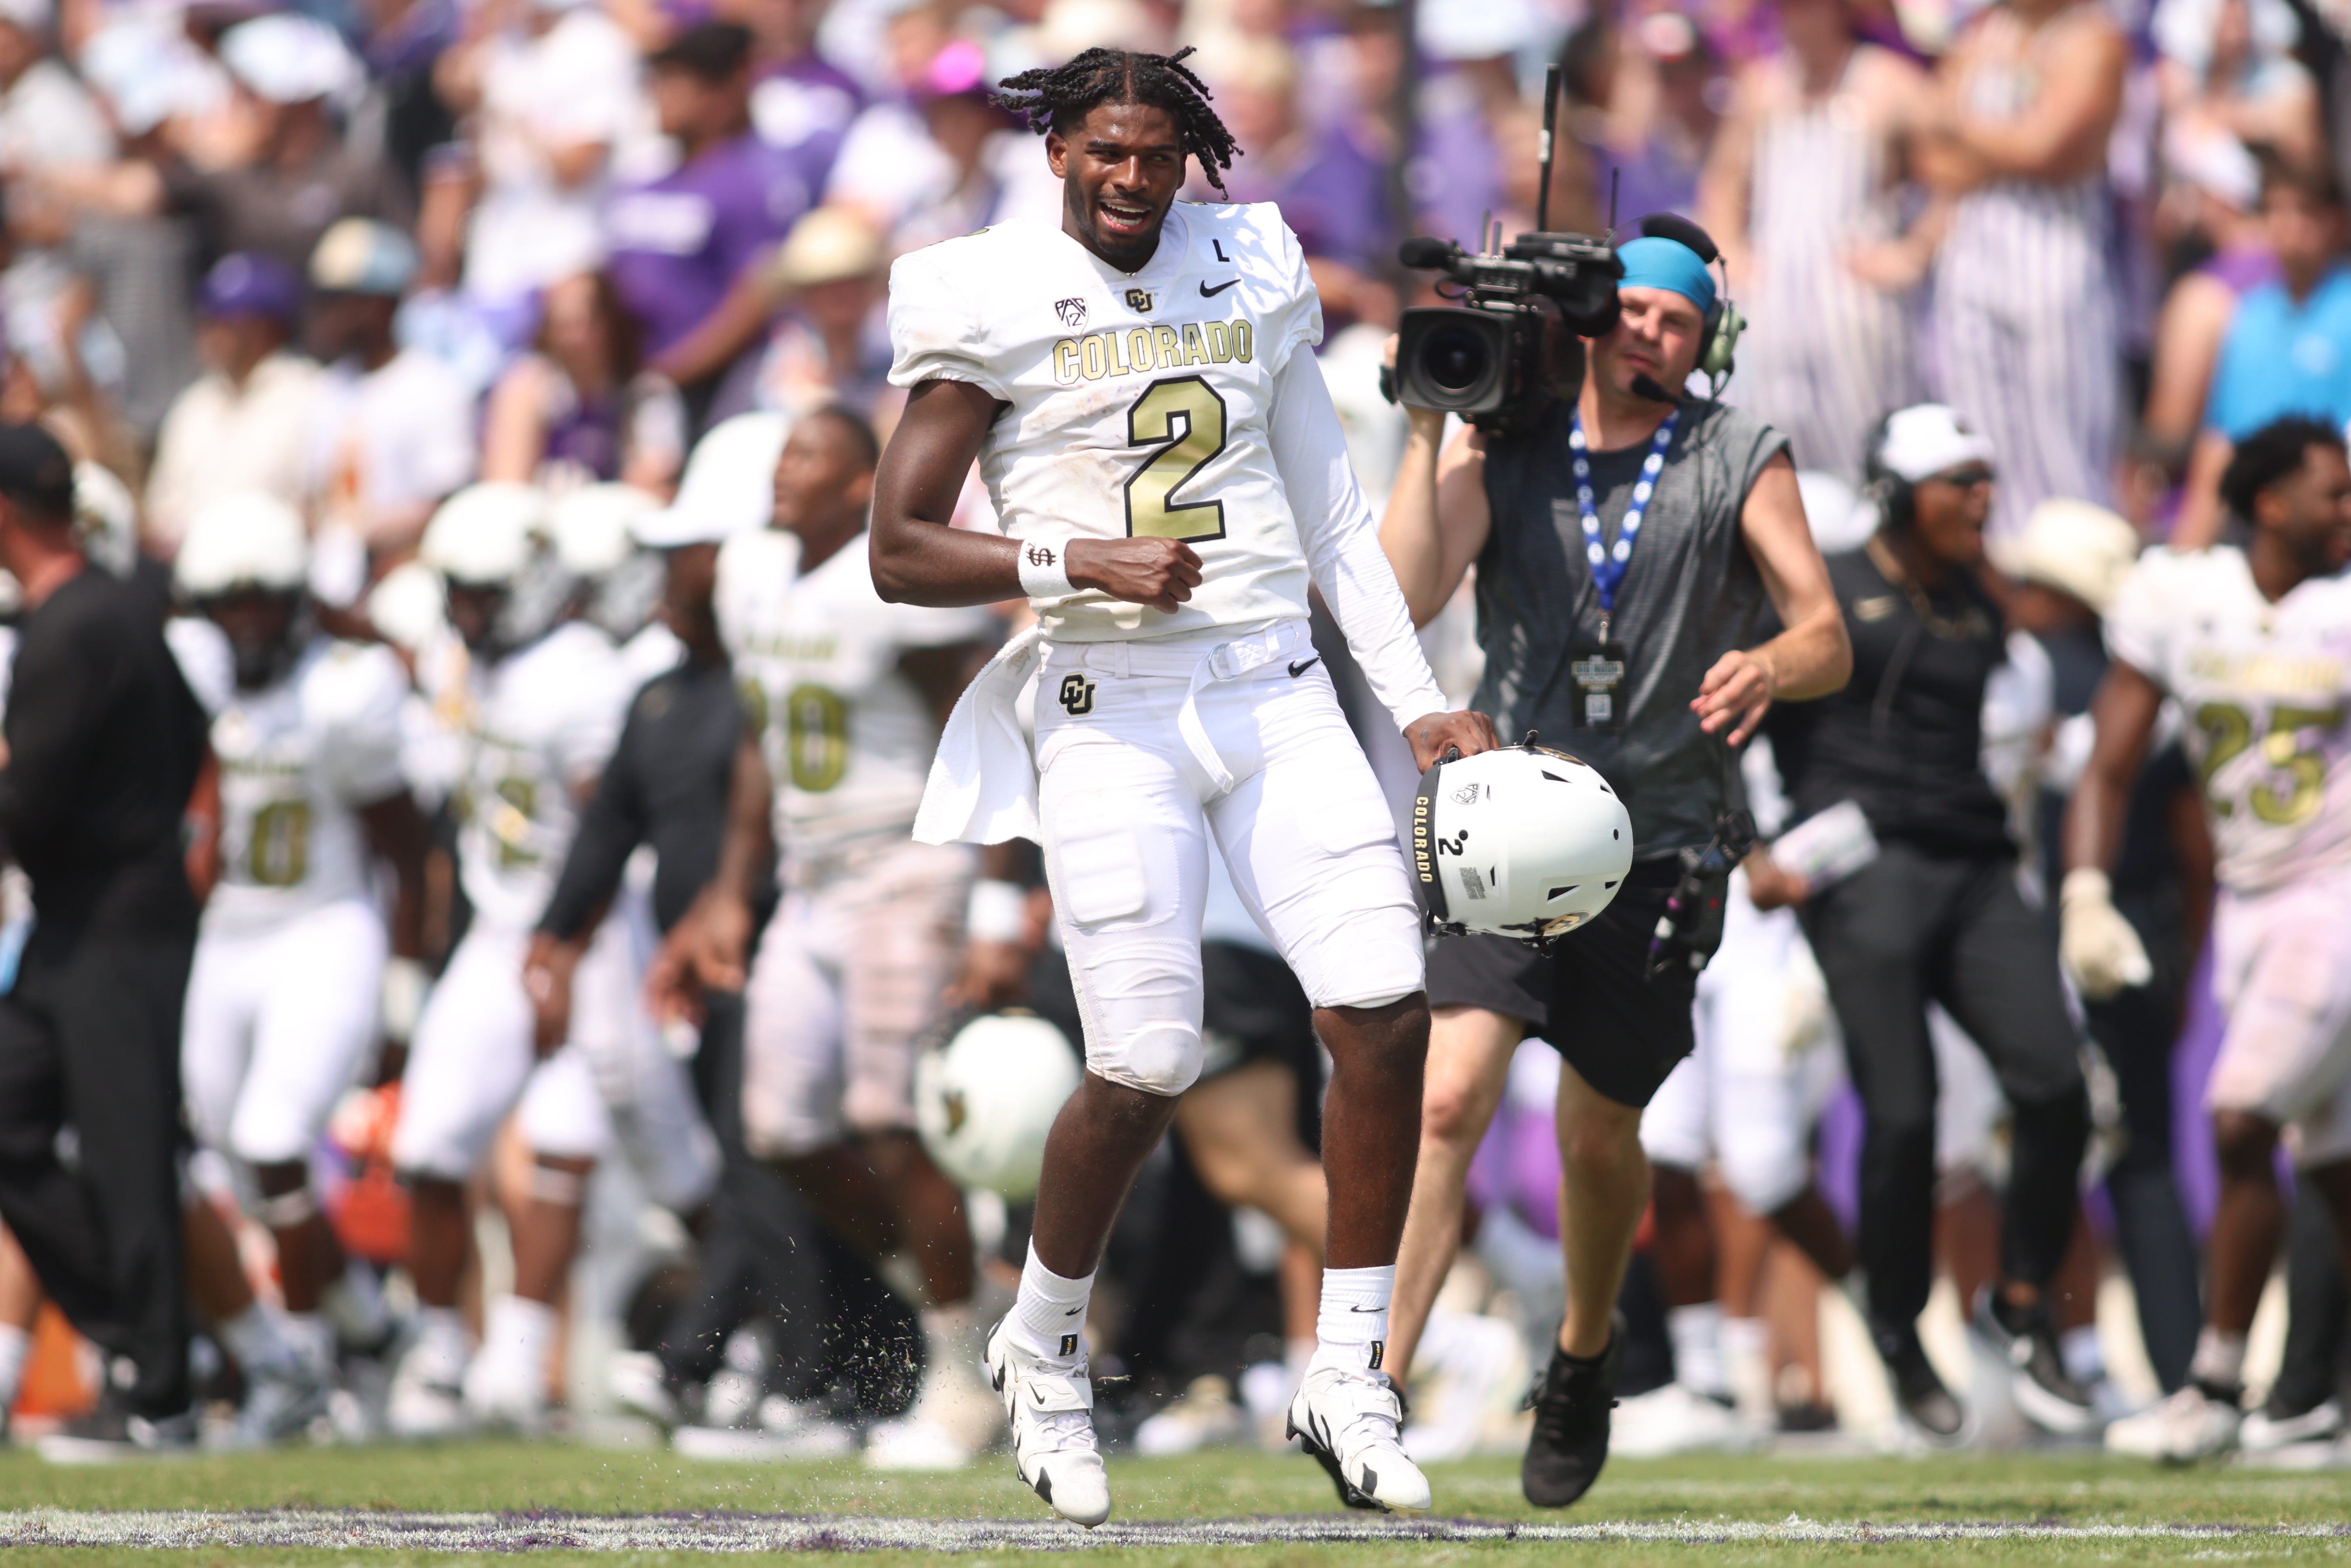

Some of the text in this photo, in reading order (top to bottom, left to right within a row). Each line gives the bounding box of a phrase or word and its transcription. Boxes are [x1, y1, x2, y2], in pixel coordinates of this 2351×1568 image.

[1212, 238, 1230, 263] L
[1054, 297, 1086, 321] PAC
[1066, 313, 1082, 327] 12
[1053, 319, 1253, 385] COLORADO
[1124, 374, 1226, 543] 2
[1414, 796, 1433, 882] COLORADO
[1438, 838, 1464, 856] 2
